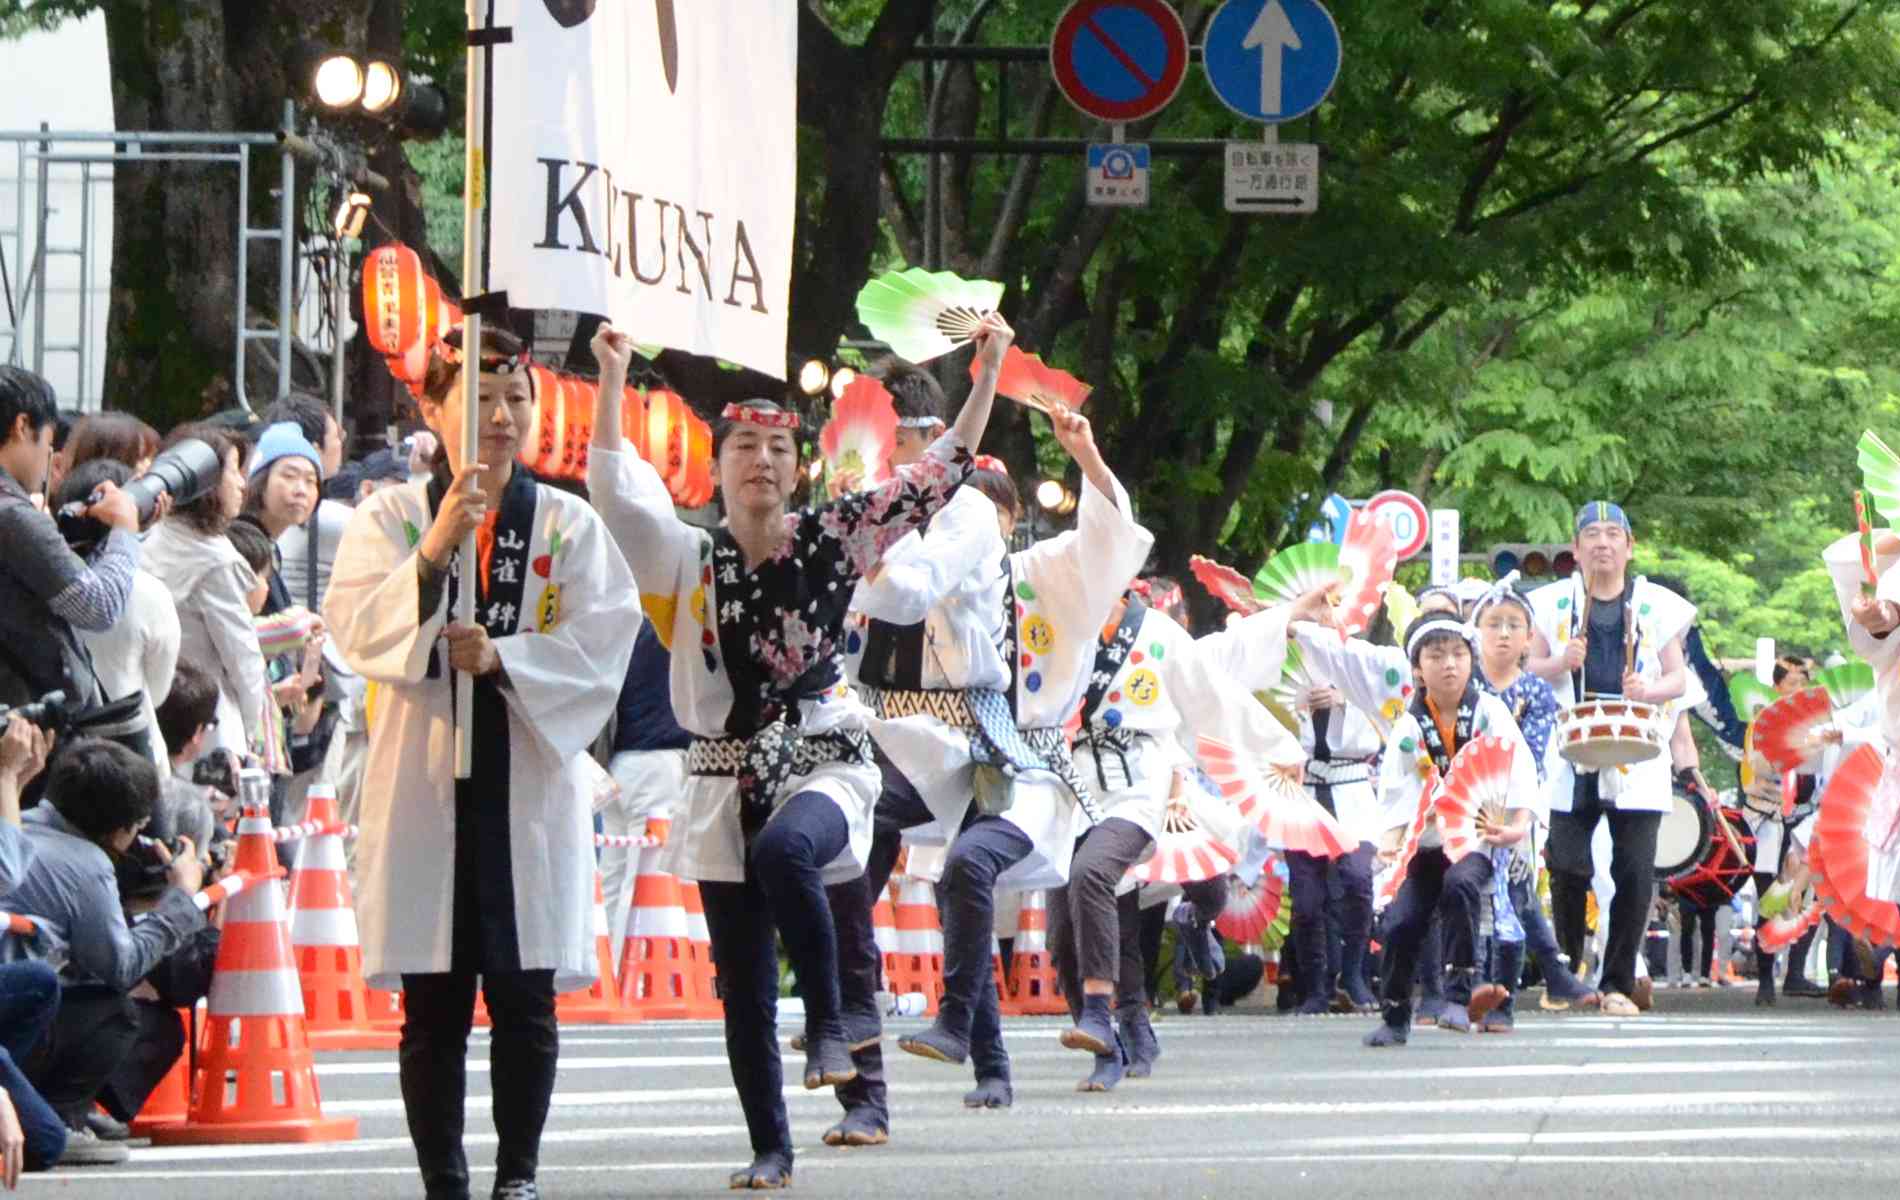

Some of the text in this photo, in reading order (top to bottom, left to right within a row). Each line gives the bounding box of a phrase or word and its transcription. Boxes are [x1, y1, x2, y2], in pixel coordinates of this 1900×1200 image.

[492, 528, 526, 632] 山雀絆
[715, 546, 745, 625] 山雀絆
